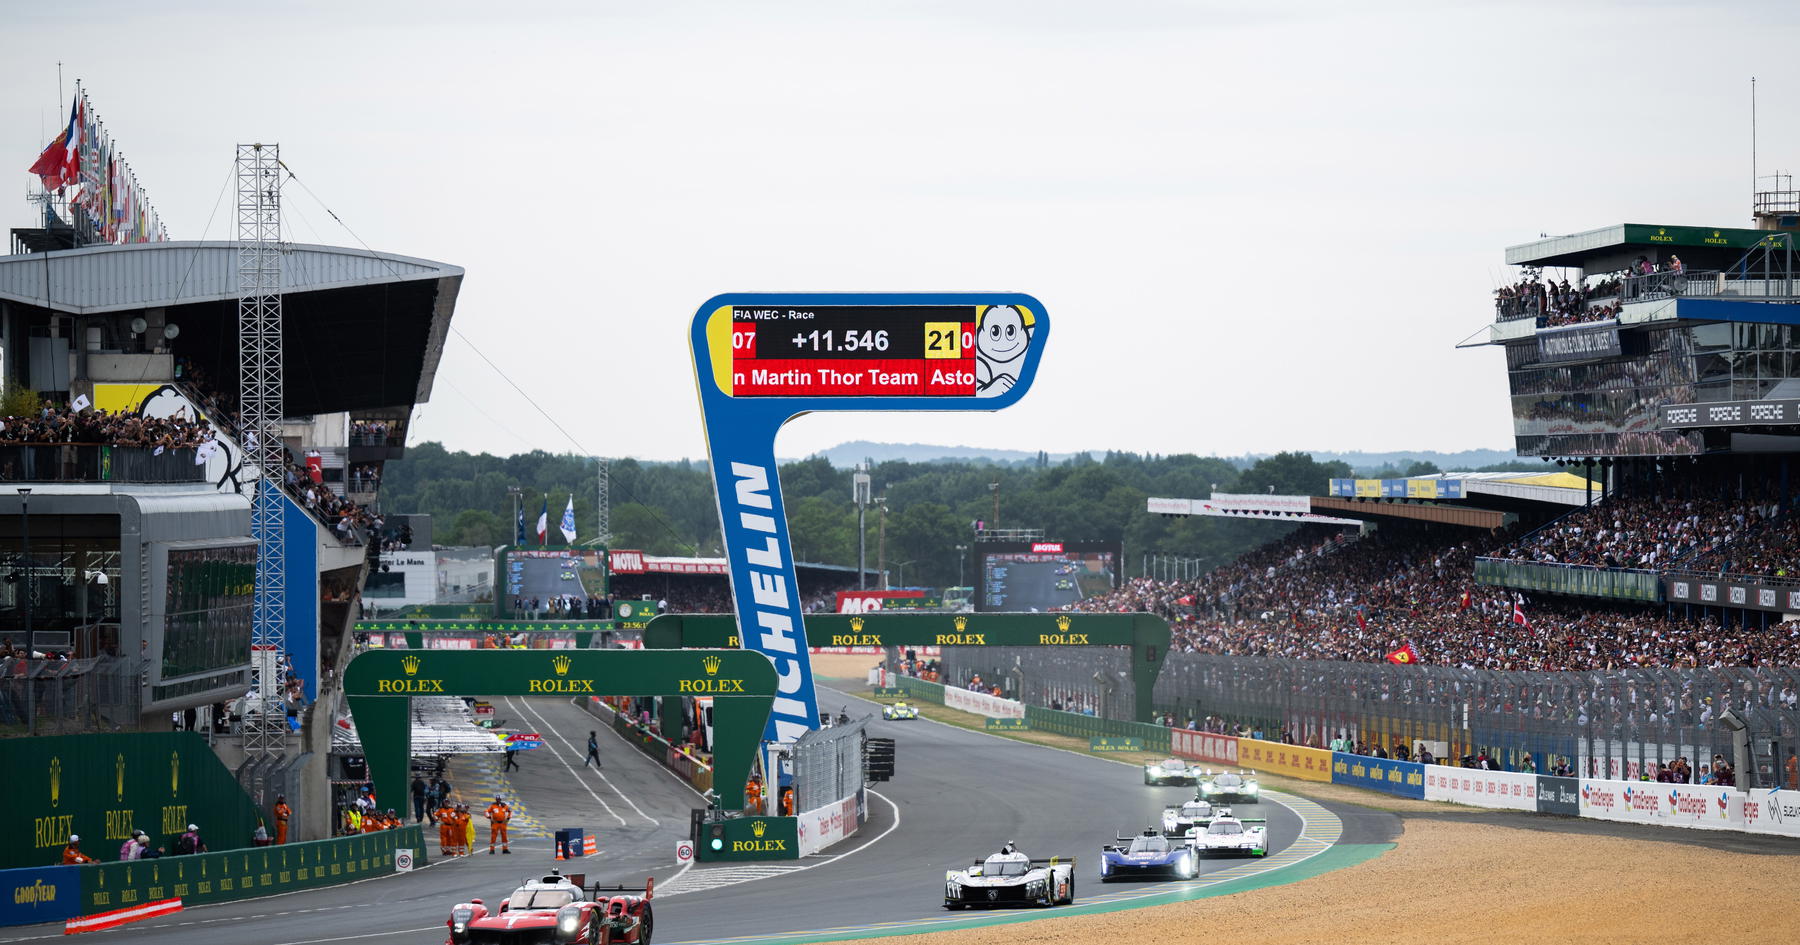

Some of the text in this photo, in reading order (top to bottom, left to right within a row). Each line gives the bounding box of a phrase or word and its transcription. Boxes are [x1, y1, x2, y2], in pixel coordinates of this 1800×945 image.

[734, 310, 751, 320] FIA
[754, 310, 779, 320] WEC
[788, 310, 815, 320] Race
[733, 330, 889, 351] 07 +11.546
[928, 330, 976, 351] 21 0
[752, 369, 812, 385] Martin
[817, 369, 863, 385] Thor
[868, 369, 918, 385] Team
[930, 369, 975, 385] Asto
[1667, 408, 1697, 423] PORSCHE
[1709, 406, 1741, 421] PORSCHE
[1750, 404, 1783, 420] PORSCHE
[612, 553, 643, 571] MOTUL
[832, 634, 882, 646] ROLEX
[936, 634, 986, 645] ROLEX
[1039, 634, 1089, 645] ROLEX
[378, 679, 444, 693] ROLEX
[529, 679, 594, 693] ROLEX
[679, 679, 744, 693] ROLEX
[106, 809, 134, 840] ROLEX
[163, 805, 189, 835] ROLEX
[35, 814, 73, 848] ROLEX
[680, 848, 690, 857] 60
[732, 839, 786, 852] ROLEX
[14, 880, 56, 908] GOODYEAR
